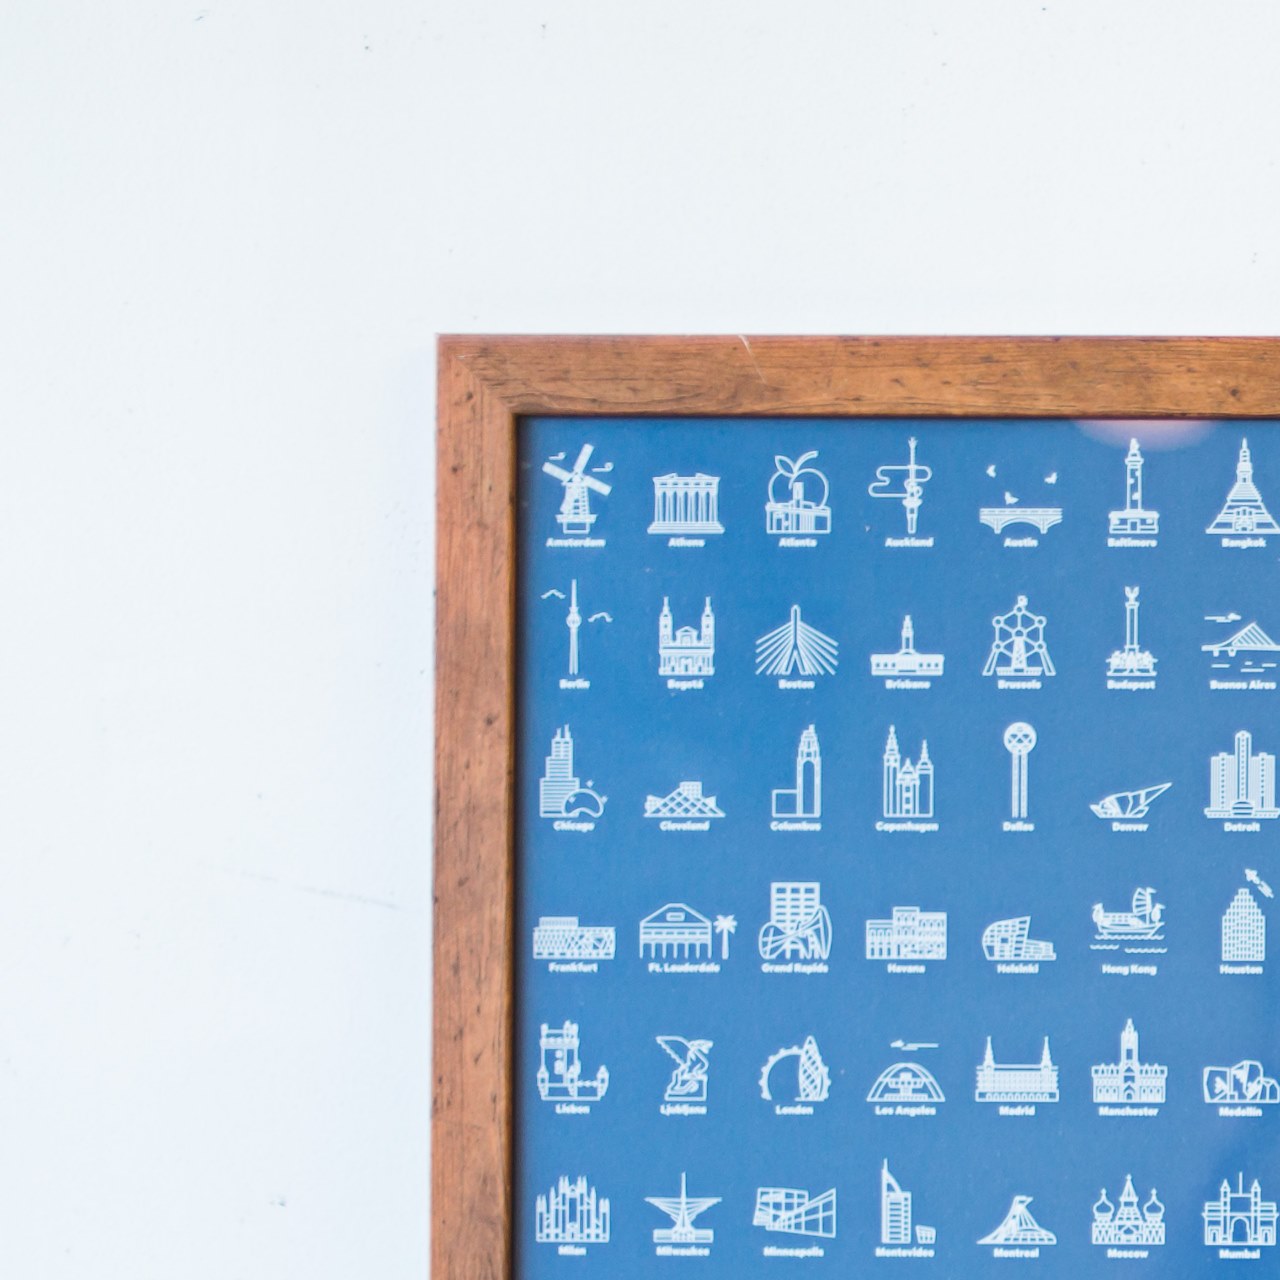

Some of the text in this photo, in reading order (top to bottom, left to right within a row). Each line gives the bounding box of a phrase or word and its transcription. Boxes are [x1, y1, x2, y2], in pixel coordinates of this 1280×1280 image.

[546, 537, 605, 547] Amsterdam
[668, 537, 705, 547] Athens
[779, 537, 817, 547] Atlanta
[885, 537, 934, 547] Auckland
[1004, 537, 1038, 547] Austin
[1107, 537, 1157, 547] Baltimore
[1222, 537, 1266, 549] Bangkok
[559, 679, 590, 689] Berlin
[778, 679, 815, 689] Boston
[885, 679, 930, 689] Brisbane
[998, 679, 1041, 689] Brussels
[1107, 680, 1155, 691] Budapest
[1210, 680, 1276, 689] Buenos Aires
[553, 821, 594, 832] Chicago
[660, 821, 709, 831] Cleveland
[770, 821, 821, 831] Columbus
[875, 821, 939, 832] Copenhagen
[1003, 821, 1034, 831] Dallas
[1112, 822, 1148, 831] Denver
[1224, 822, 1260, 831] Detroit
[549, 962, 597, 972] Frankfurt
[648, 963, 720, 972] Ft. Lauderdale
[761, 963, 828, 974] Grand Rapids
[887, 963, 925, 973] Havana
[997, 963, 1039, 973] Helsinki
[1102, 964, 1157, 976] Hong Kong
[1220, 964, 1263, 974] Houston
[556, 1103, 590, 1114] Lisbon
[775, 1105, 813, 1115] London
[875, 1105, 936, 1117] Los Angeles
[999, 1106, 1035, 1115] Madrid
[1098, 1106, 1158, 1116] Manchester
[558, 1245, 586, 1255] Milan
[656, 1246, 710, 1256] Milwaukee
[763, 1246, 824, 1258] Minneapolis
[875, 1247, 934, 1257] Montevideo
[993, 1248, 1039, 1257] Montreal
[1107, 1249, 1148, 1258] Moscow
[1219, 1249, 1260, 1259] Mumbai
